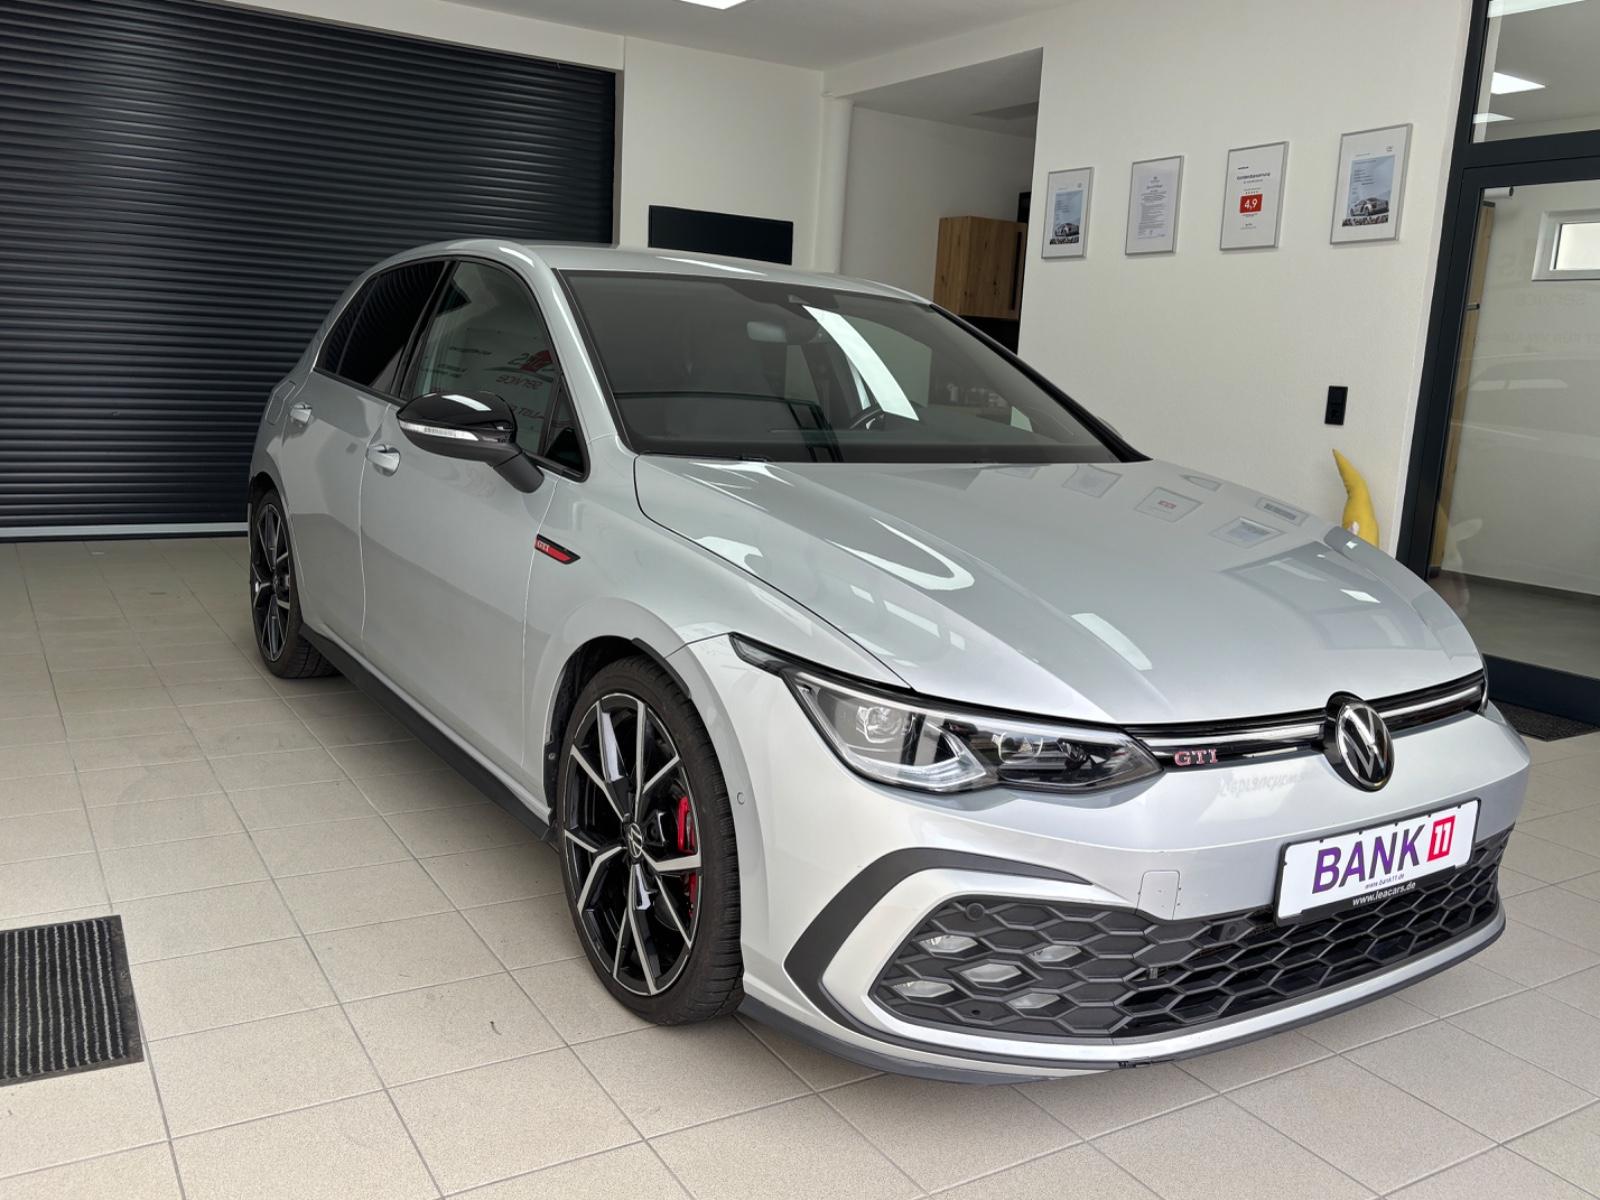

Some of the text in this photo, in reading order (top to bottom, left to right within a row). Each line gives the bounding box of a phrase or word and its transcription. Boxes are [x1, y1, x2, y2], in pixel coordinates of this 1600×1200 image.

[1244, 198, 1258, 211] 4,9
[1173, 749, 1218, 767] GTI
[1312, 821, 1454, 894] BANK 11
[1364, 873, 1405, 890] www.bank11.de
[1352, 881, 1416, 906] www.leacars.de
